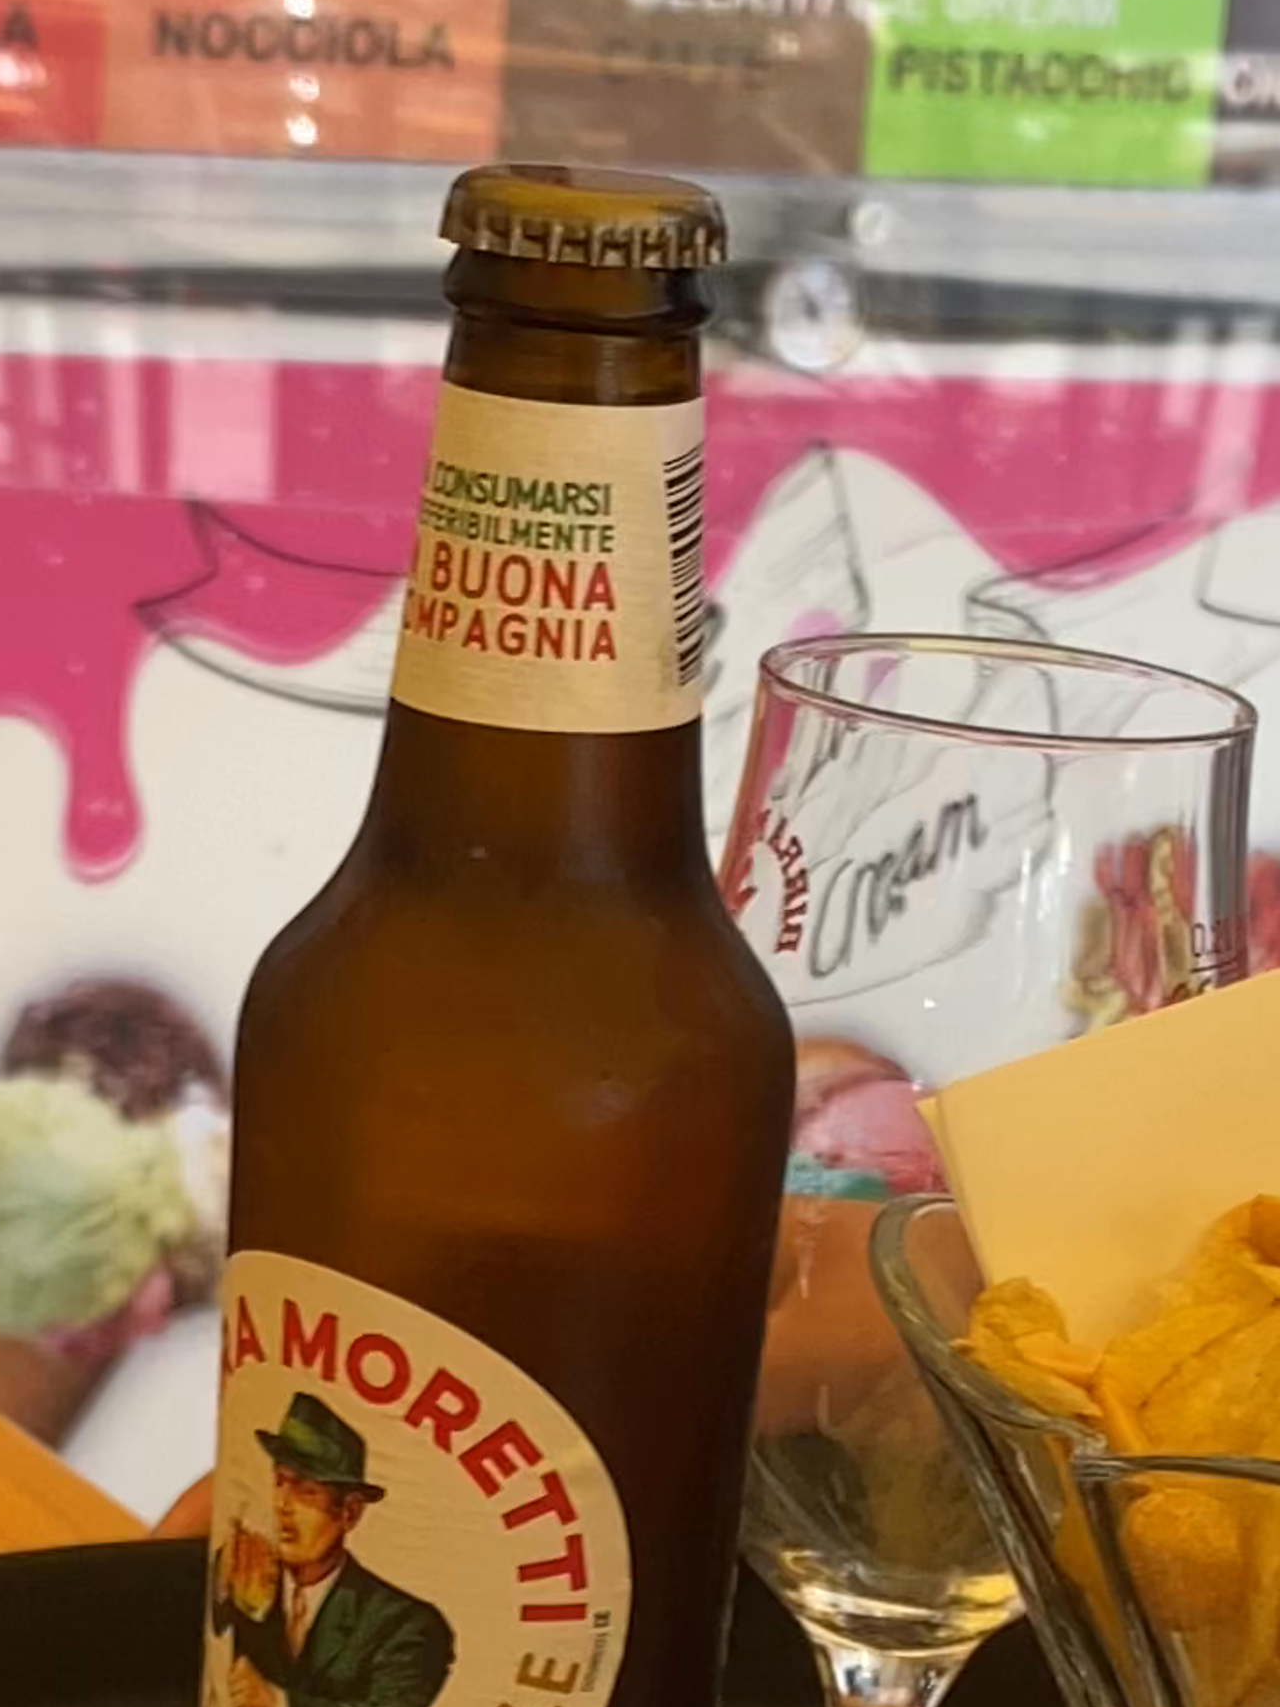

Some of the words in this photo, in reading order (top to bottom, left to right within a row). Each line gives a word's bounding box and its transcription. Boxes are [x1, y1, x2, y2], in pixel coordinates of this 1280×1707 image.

[150, 8, 456, 69] NOCCIOLA
[888, 45, 1193, 102] PISTACCHIO
[433, 461, 612, 516] CONSUMARSI
[432, 540, 615, 612] BUONA
[281, 1298, 591, 1625] MORETTI
